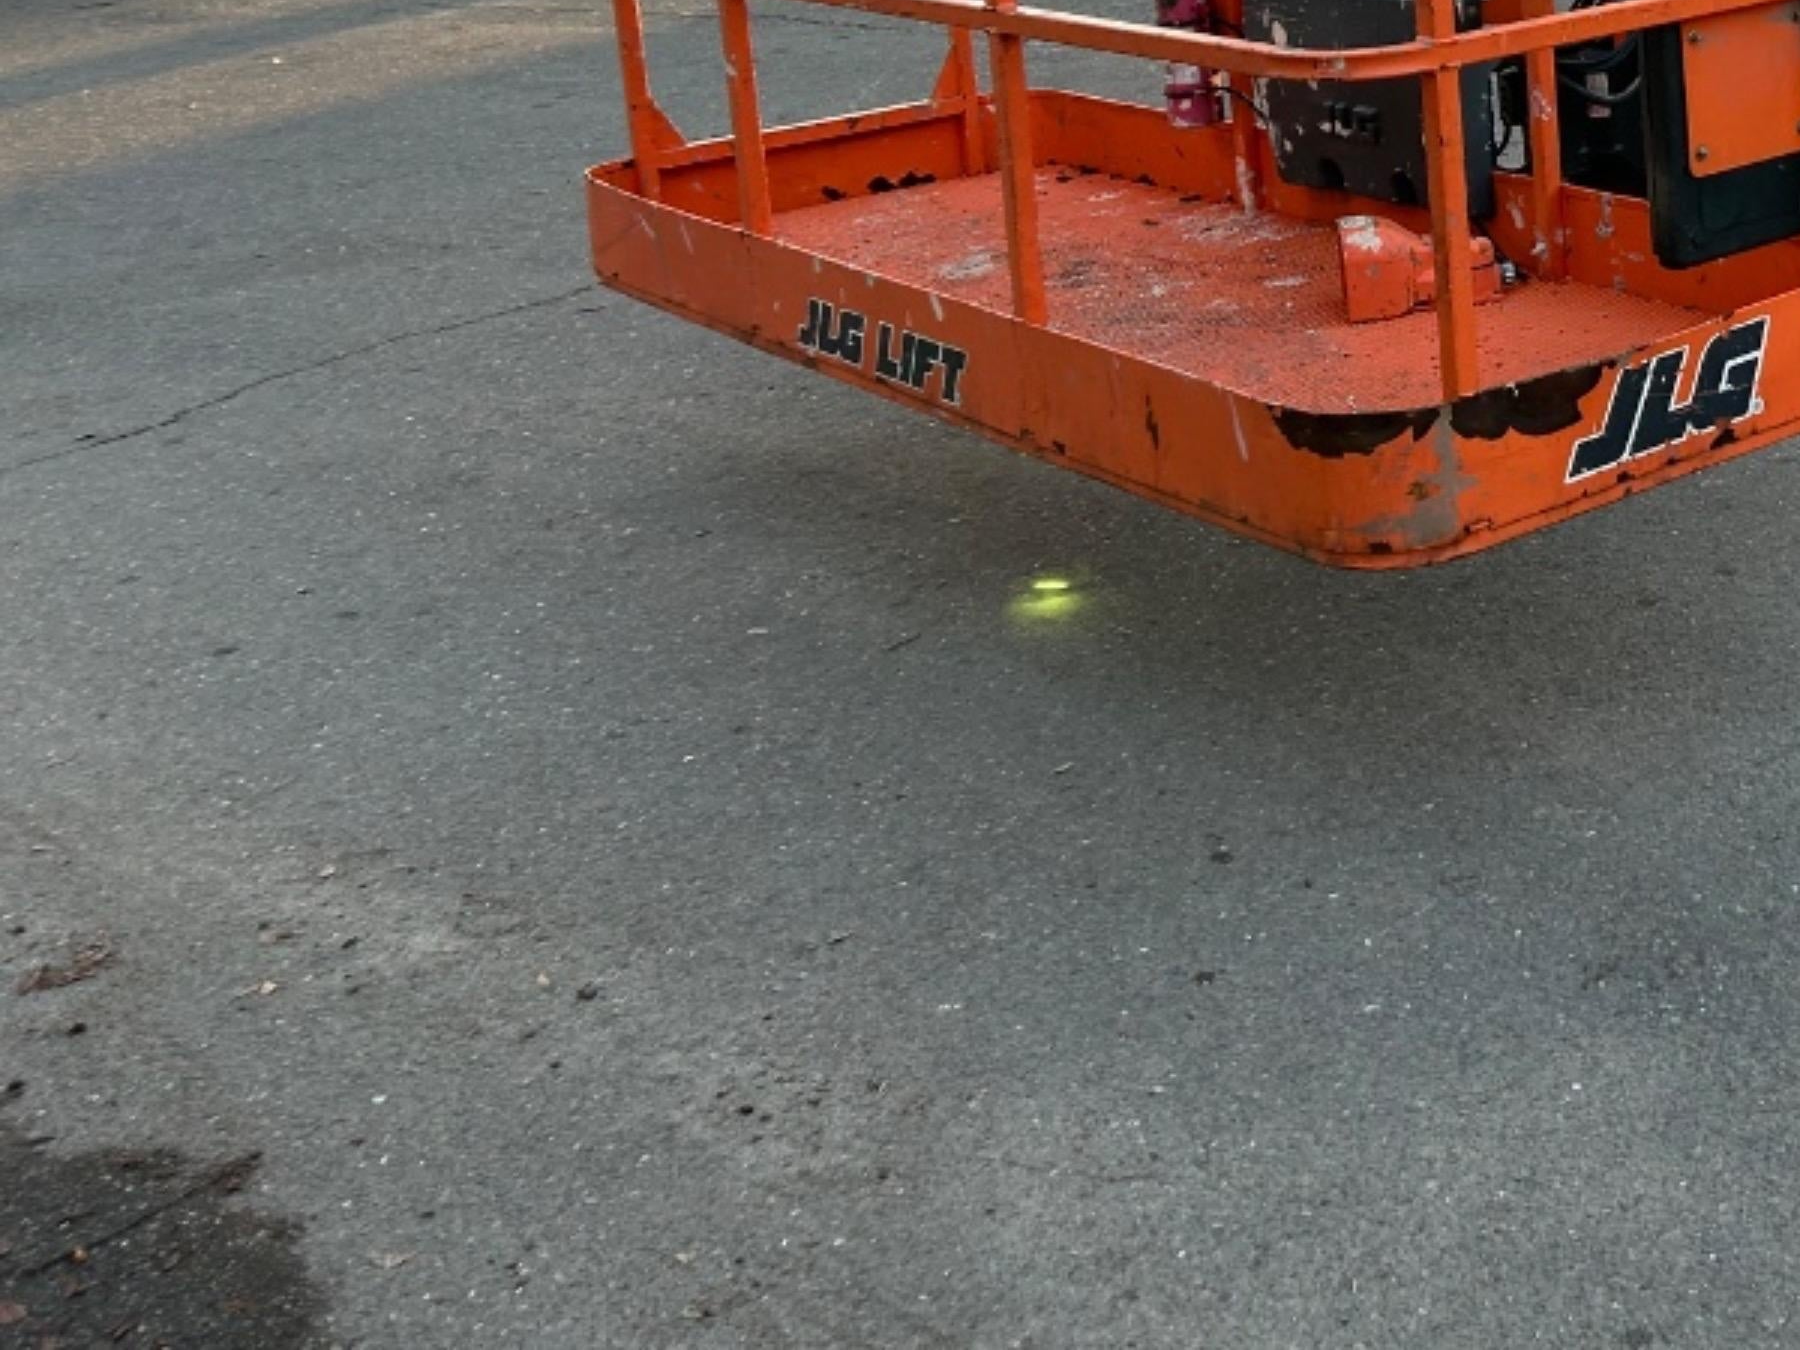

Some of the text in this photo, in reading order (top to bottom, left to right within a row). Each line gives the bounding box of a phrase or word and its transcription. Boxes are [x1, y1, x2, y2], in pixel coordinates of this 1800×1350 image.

[798, 297, 969, 405] JLG LIFT
[1564, 314, 1770, 484] JLG
